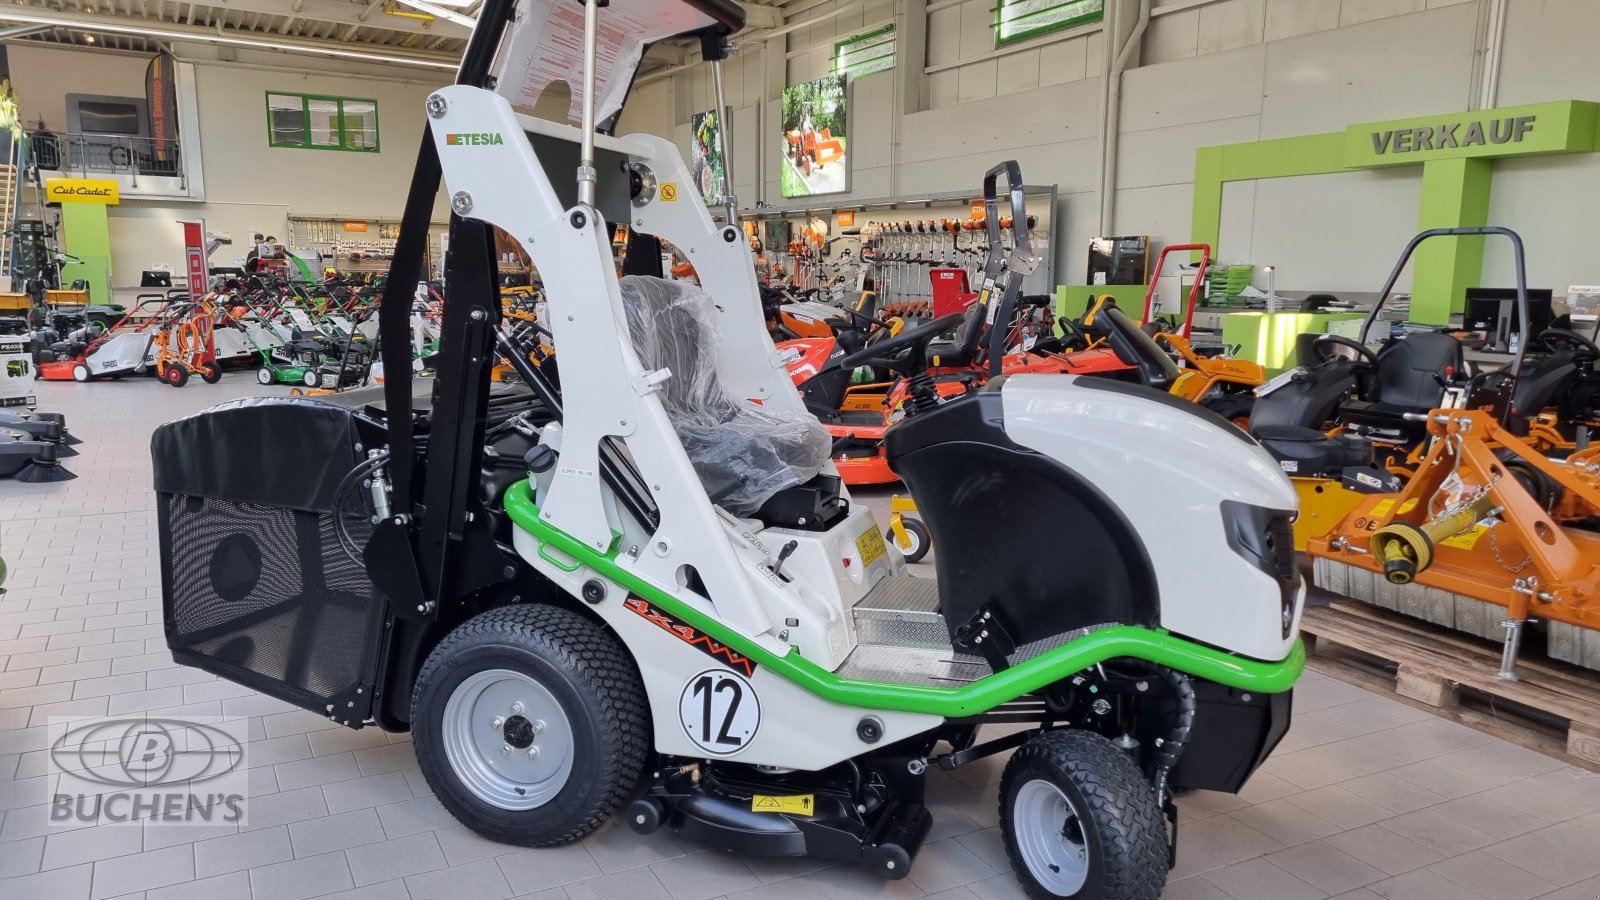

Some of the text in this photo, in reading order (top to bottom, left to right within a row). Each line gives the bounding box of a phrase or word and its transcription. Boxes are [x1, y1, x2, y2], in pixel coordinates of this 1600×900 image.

[446, 132, 504, 146] ETESIA
[1371, 115, 1536, 155] VERKAUF
[53, 186, 112, 196] Cub Cadet
[693, 675, 743, 746] 12
